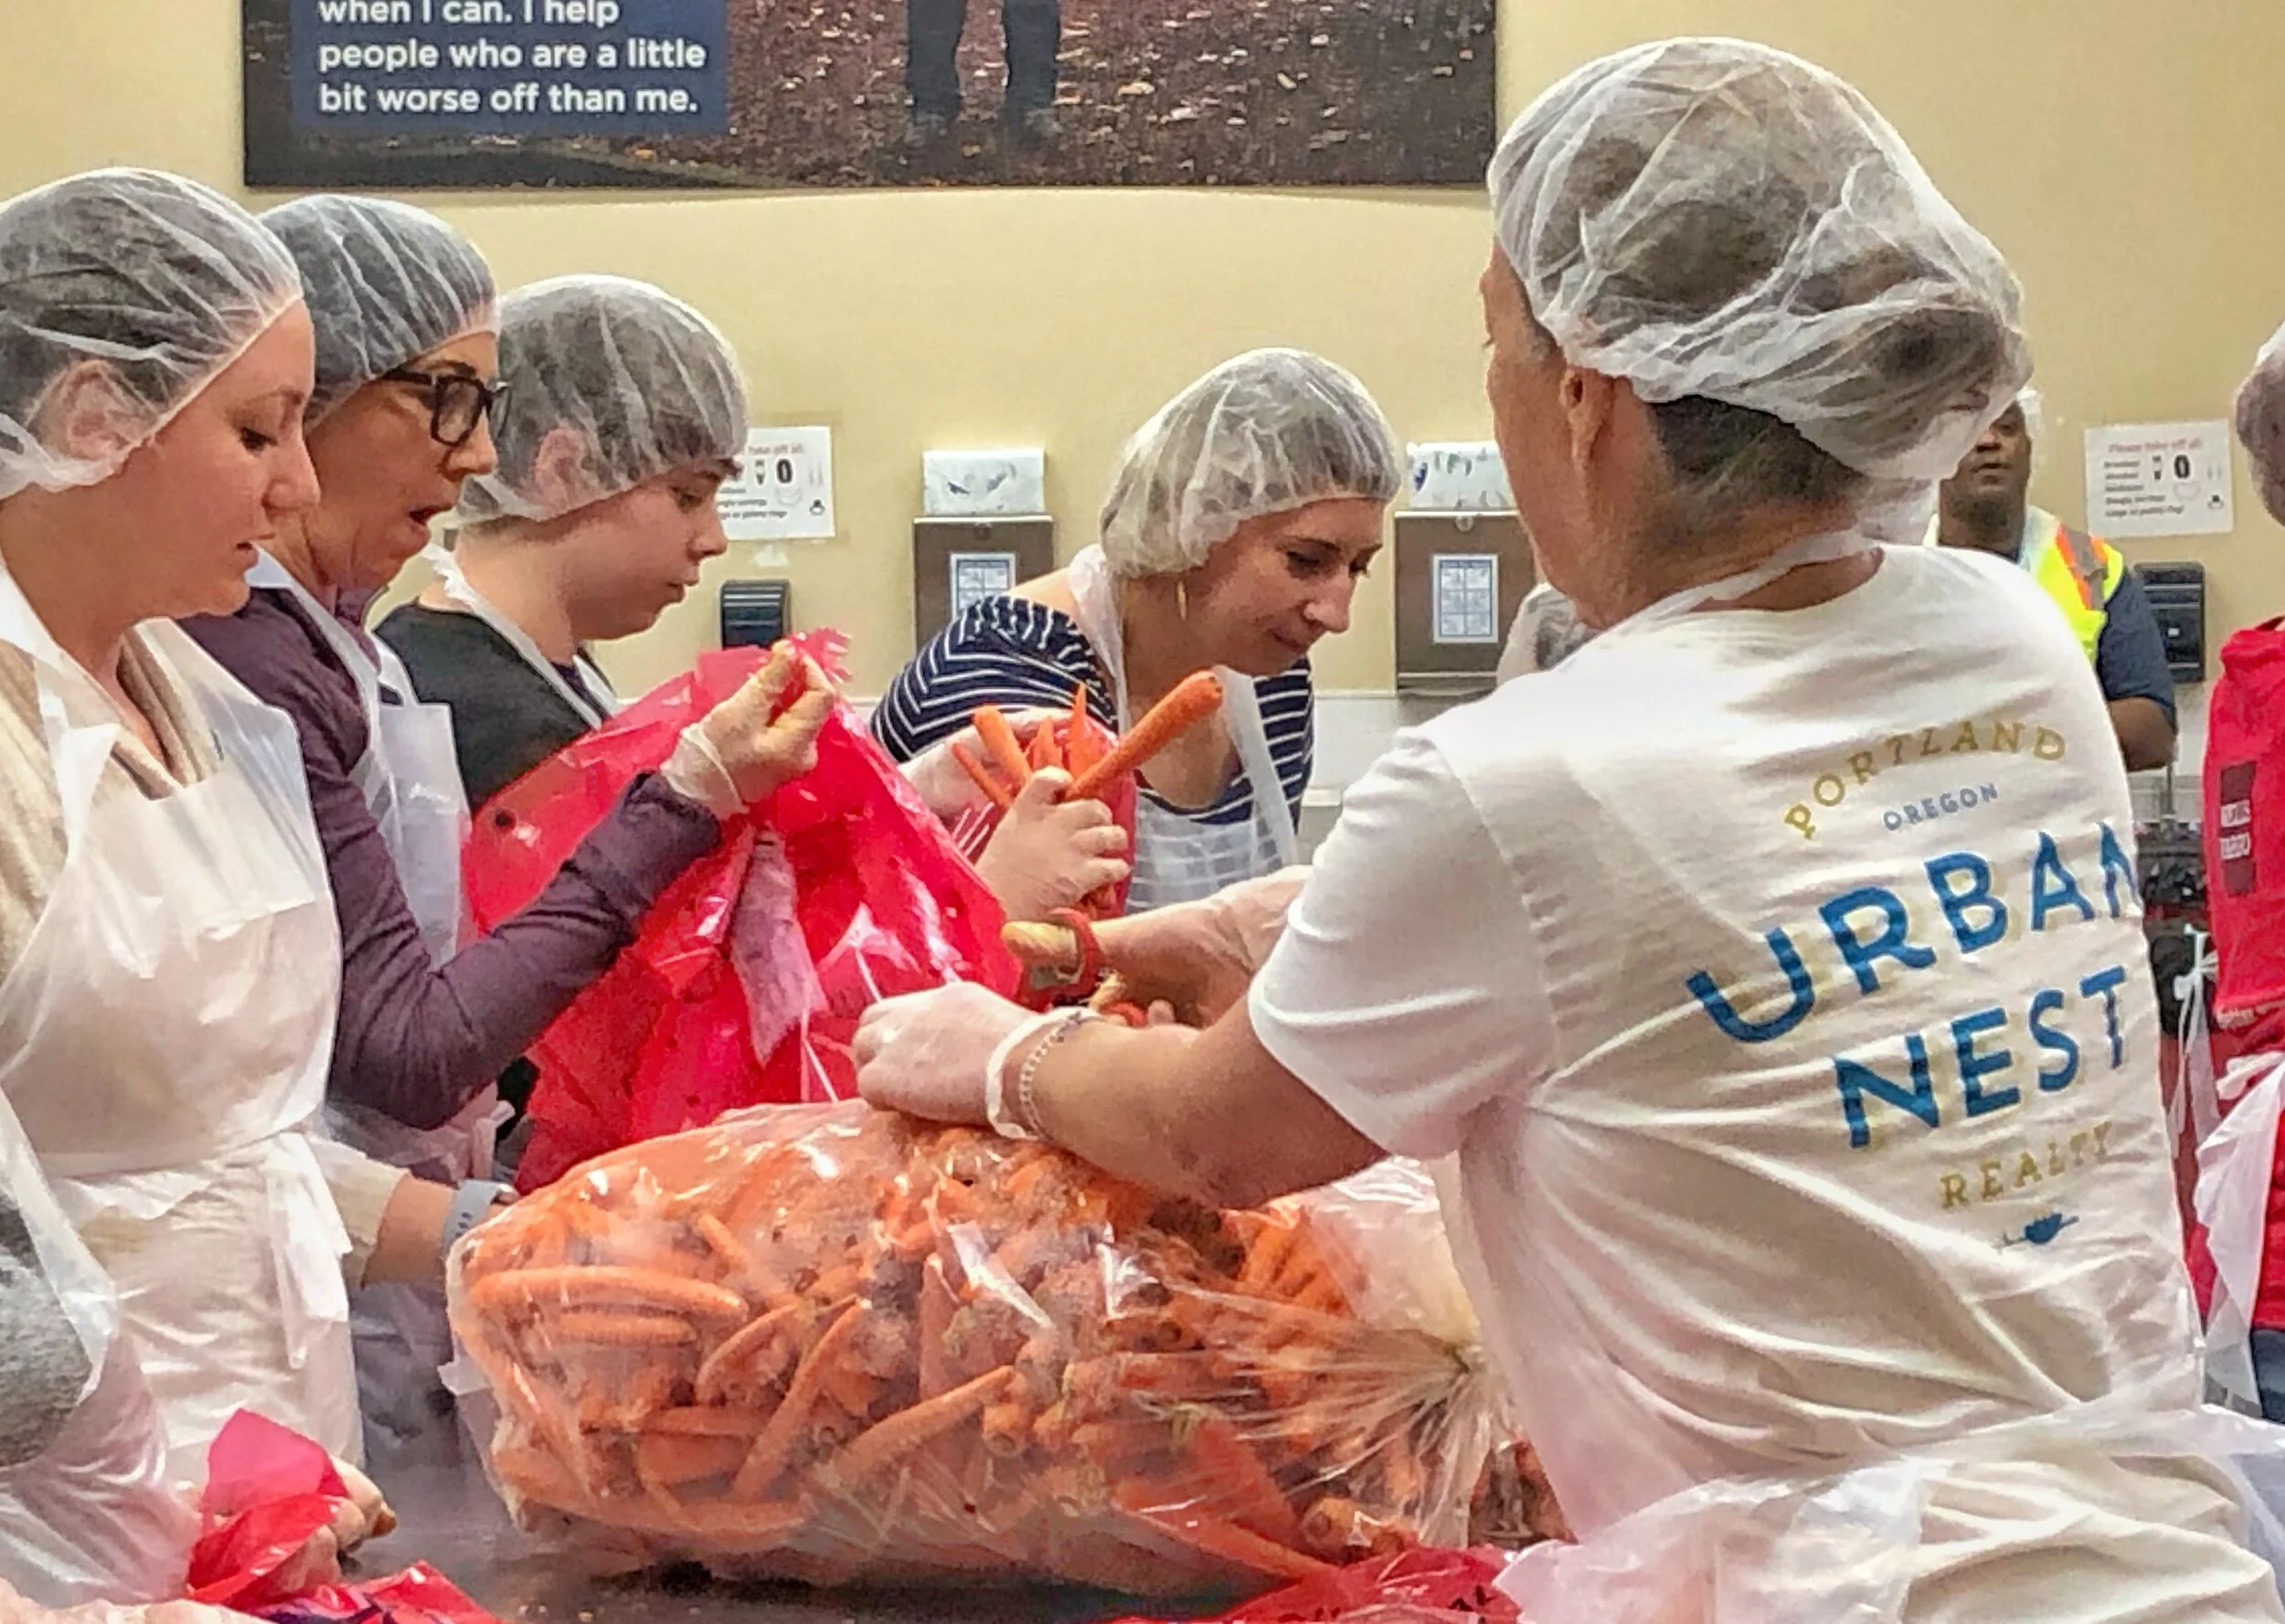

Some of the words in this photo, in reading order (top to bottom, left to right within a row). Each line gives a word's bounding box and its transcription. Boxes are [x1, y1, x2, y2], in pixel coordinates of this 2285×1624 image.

[320, 0, 410, 23] when
[422, 0, 431, 23] I
[442, 0, 513, 23] can.
[524, 0, 533, 23] I
[544, 0, 620, 27] help
[320, 37, 439, 73] people
[449, 37, 522, 68] who
[531, 44, 587, 68] are
[597, 44, 617, 68] a
[627, 37, 707, 68] little
[320, 82, 367, 112] bit
[377, 89, 480, 112] worse
[490, 82, 539, 112] off
[548, 83, 626, 112] than
[636, 89, 697, 112] me.
[1784, 721, 2067, 840] PORTLAND
[1883, 782, 1999, 832] OREGON
[1685, 822, 2142, 1043] URBAN
[1833, 965, 2127, 1148] NEST
[1940, 1120, 2113, 1209] REALTY
